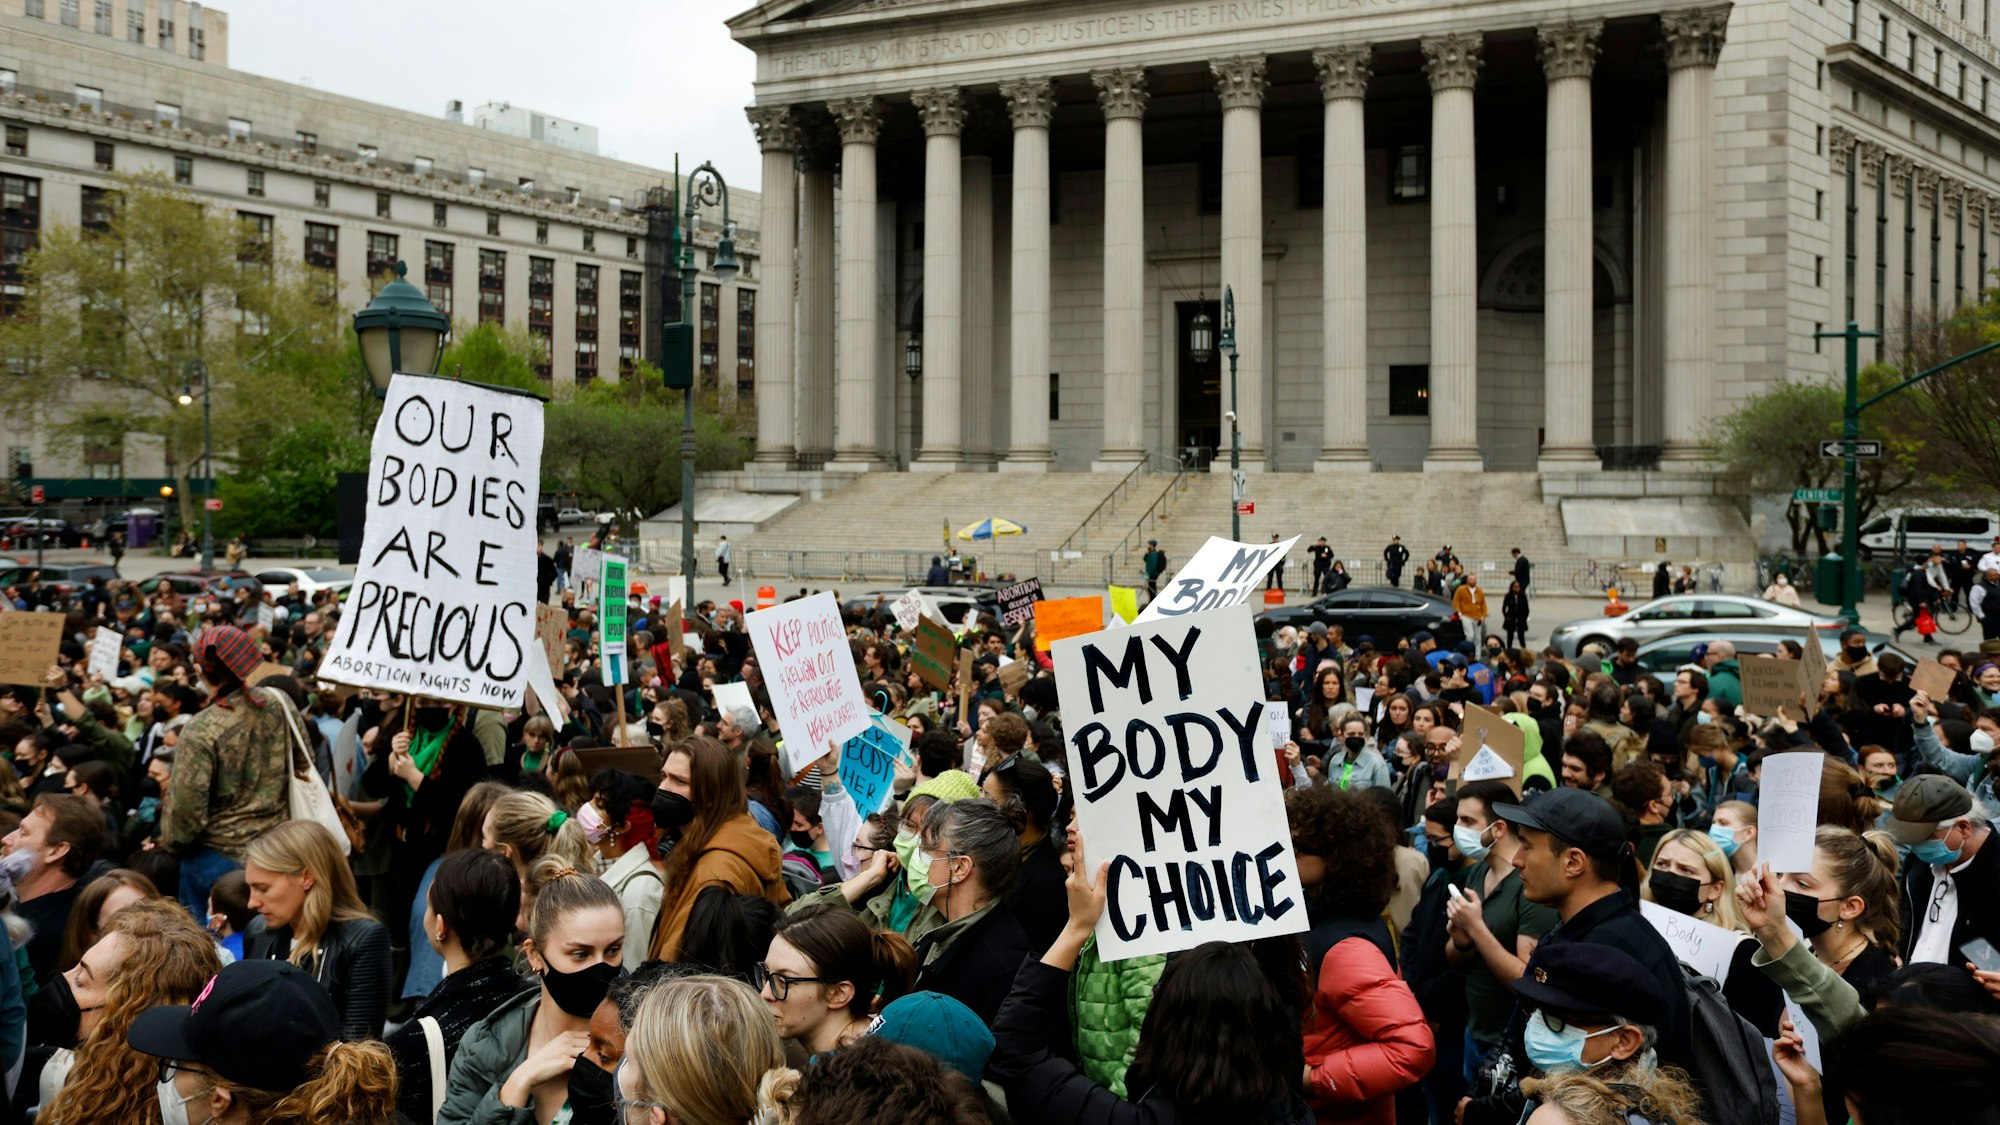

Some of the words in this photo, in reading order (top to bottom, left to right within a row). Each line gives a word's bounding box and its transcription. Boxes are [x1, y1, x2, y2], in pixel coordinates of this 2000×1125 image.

[810, 49, 852, 69] TRUE
[856, 30, 1008, 64] ADMINISTRATION
[1015, 26, 1041, 46] OF
[1047, 16, 1129, 43] JUSTICE
[1138, 13, 1155, 33] IS
[1163, 8, 1200, 29] THE
[1208, 0, 1294, 24] FIRMEST
[395, 395, 519, 467] OUR
[379, 455, 526, 529] BODIES
[1797, 489, 1828, 500] CENTRE
[372, 526, 504, 586] ARE
[1217, 546, 1280, 583] MY
[997, 579, 1040, 604] ABORTION
[1157, 578, 1259, 616] BODY
[346, 580, 527, 682] PRECIOUS
[768, 618, 803, 662] KEEP
[330, 655, 412, 684] ABORTION
[419, 671, 471, 693] RIGHTS
[480, 682, 517, 701] NOW
[817, 650, 835, 675] OUT
[1081, 625, 1201, 714] MY
[846, 736, 894, 782] BODY
[1071, 701, 1265, 804] BODY
[842, 766, 877, 806] HER
[1136, 785, 1222, 853] MY
[1106, 841, 1295, 942] CHOICE
[1665, 915, 1703, 956] Body
